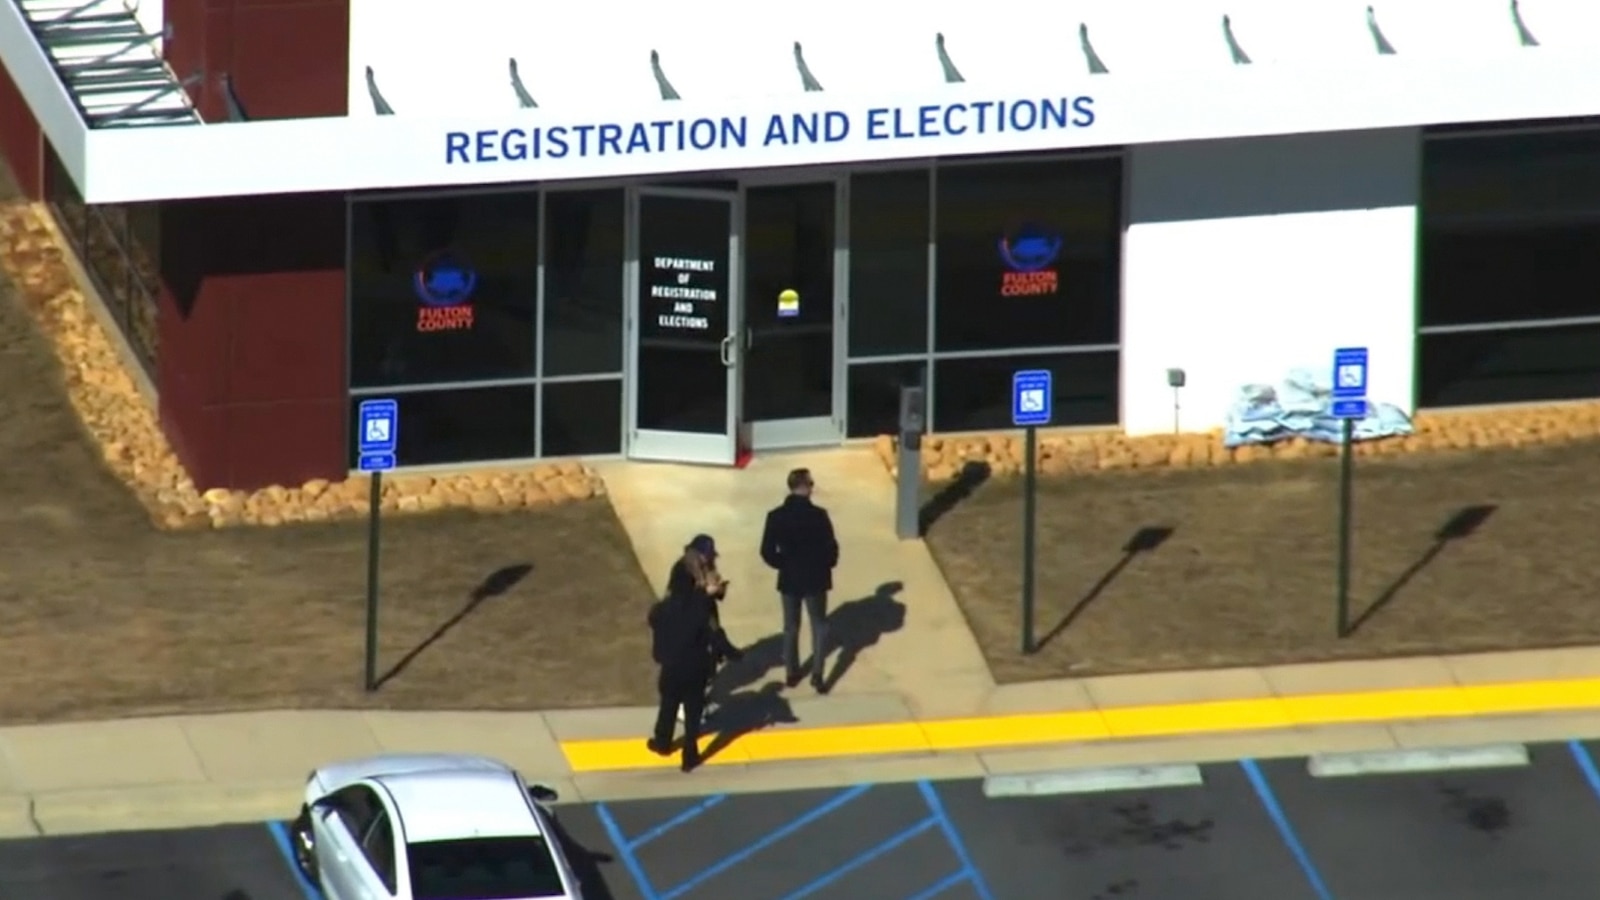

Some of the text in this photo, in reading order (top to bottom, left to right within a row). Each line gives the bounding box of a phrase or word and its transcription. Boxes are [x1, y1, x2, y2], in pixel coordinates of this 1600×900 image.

[446, 97, 1095, 163] REGISTRATION AND ELECTIONS
[654, 257, 714, 271] DEPARTMENT
[677, 273, 690, 284] OF
[1004, 271, 1058, 286] FULTON
[651, 285, 716, 300] REGISTRATION
[1001, 282, 1058, 296] COUNTY
[419, 306, 473, 322] FULTON
[673, 301, 693, 313] AND
[417, 318, 472, 332] COUNTY
[658, 315, 708, 329] ELECTIONS
